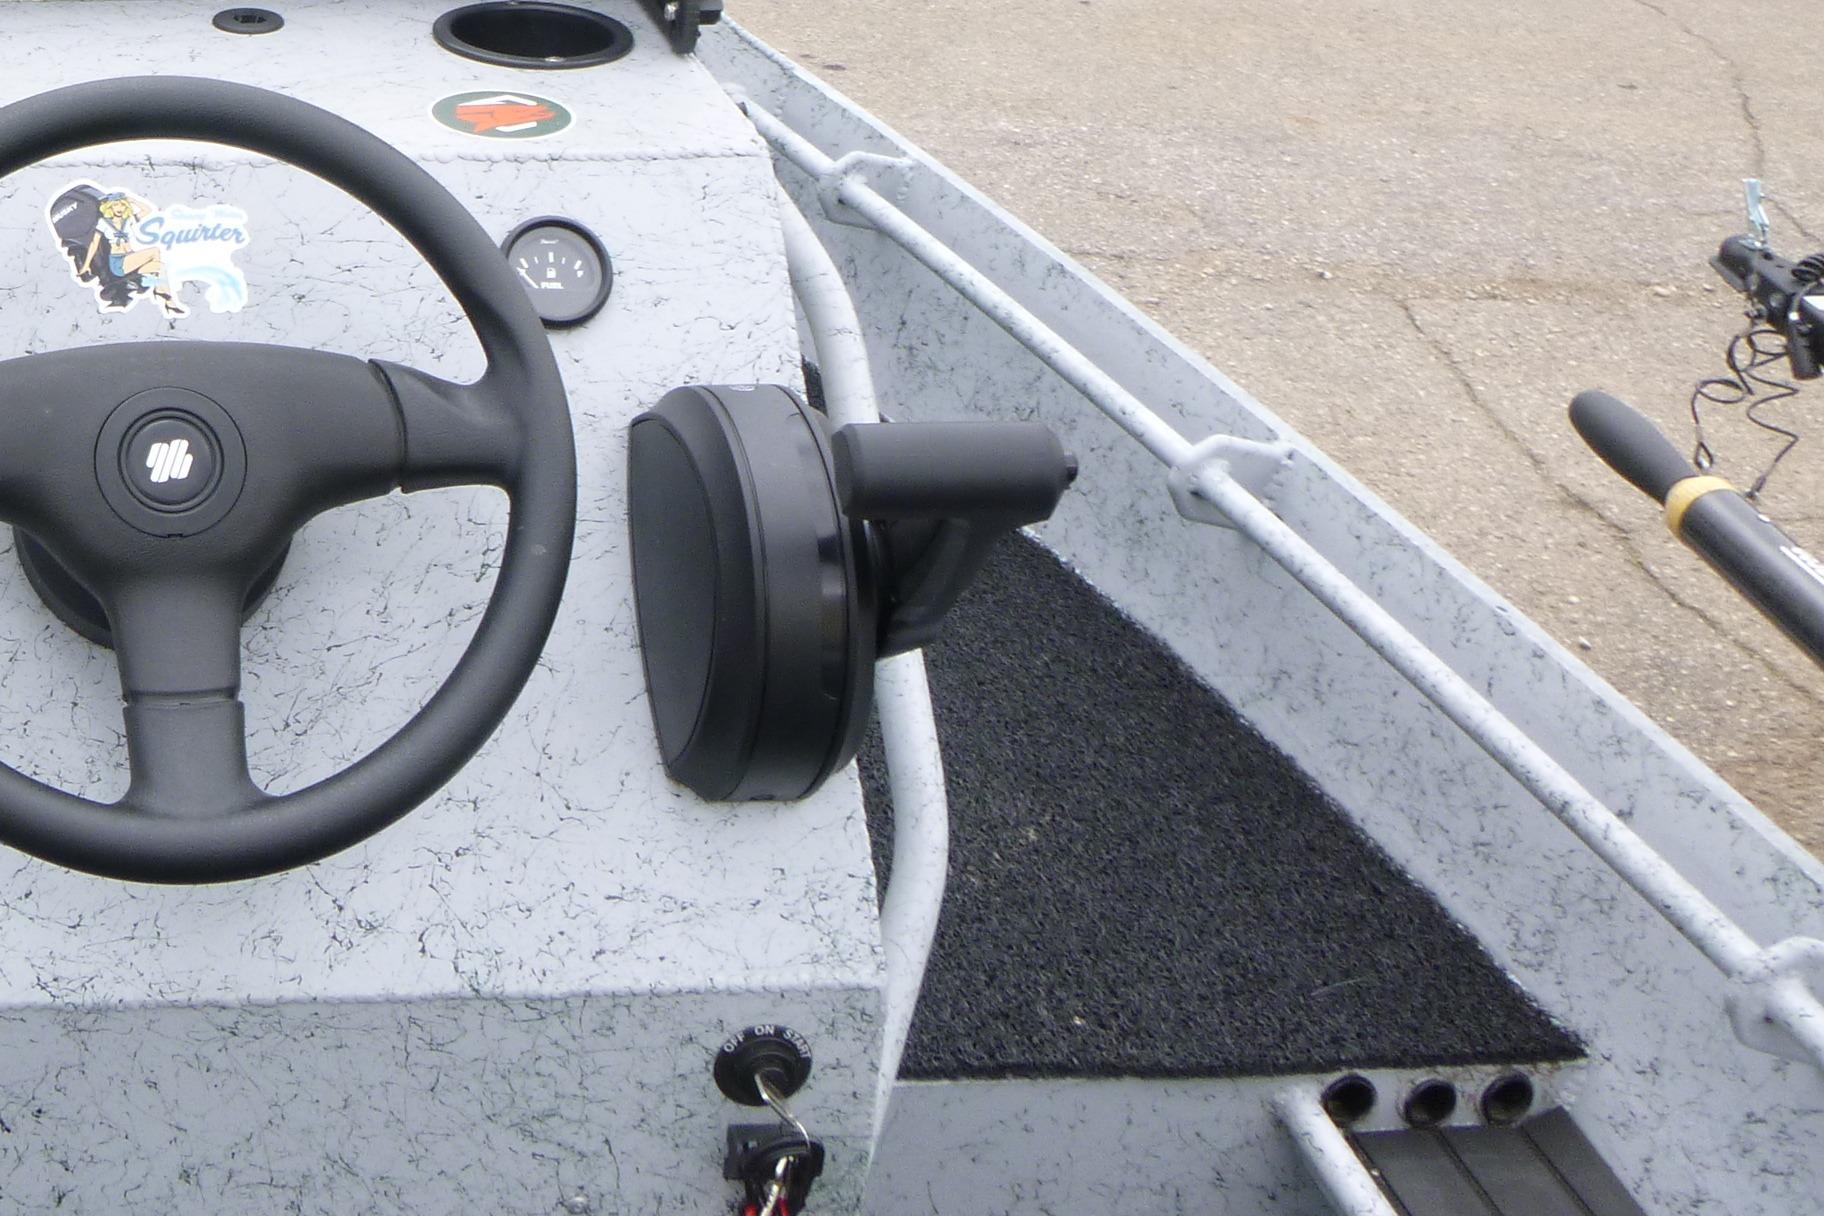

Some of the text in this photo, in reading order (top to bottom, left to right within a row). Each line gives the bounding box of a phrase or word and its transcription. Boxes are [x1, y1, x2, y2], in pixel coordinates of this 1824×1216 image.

[138, 216, 246, 250] Squirter
[723, 1025, 812, 1059] OFF ON START
